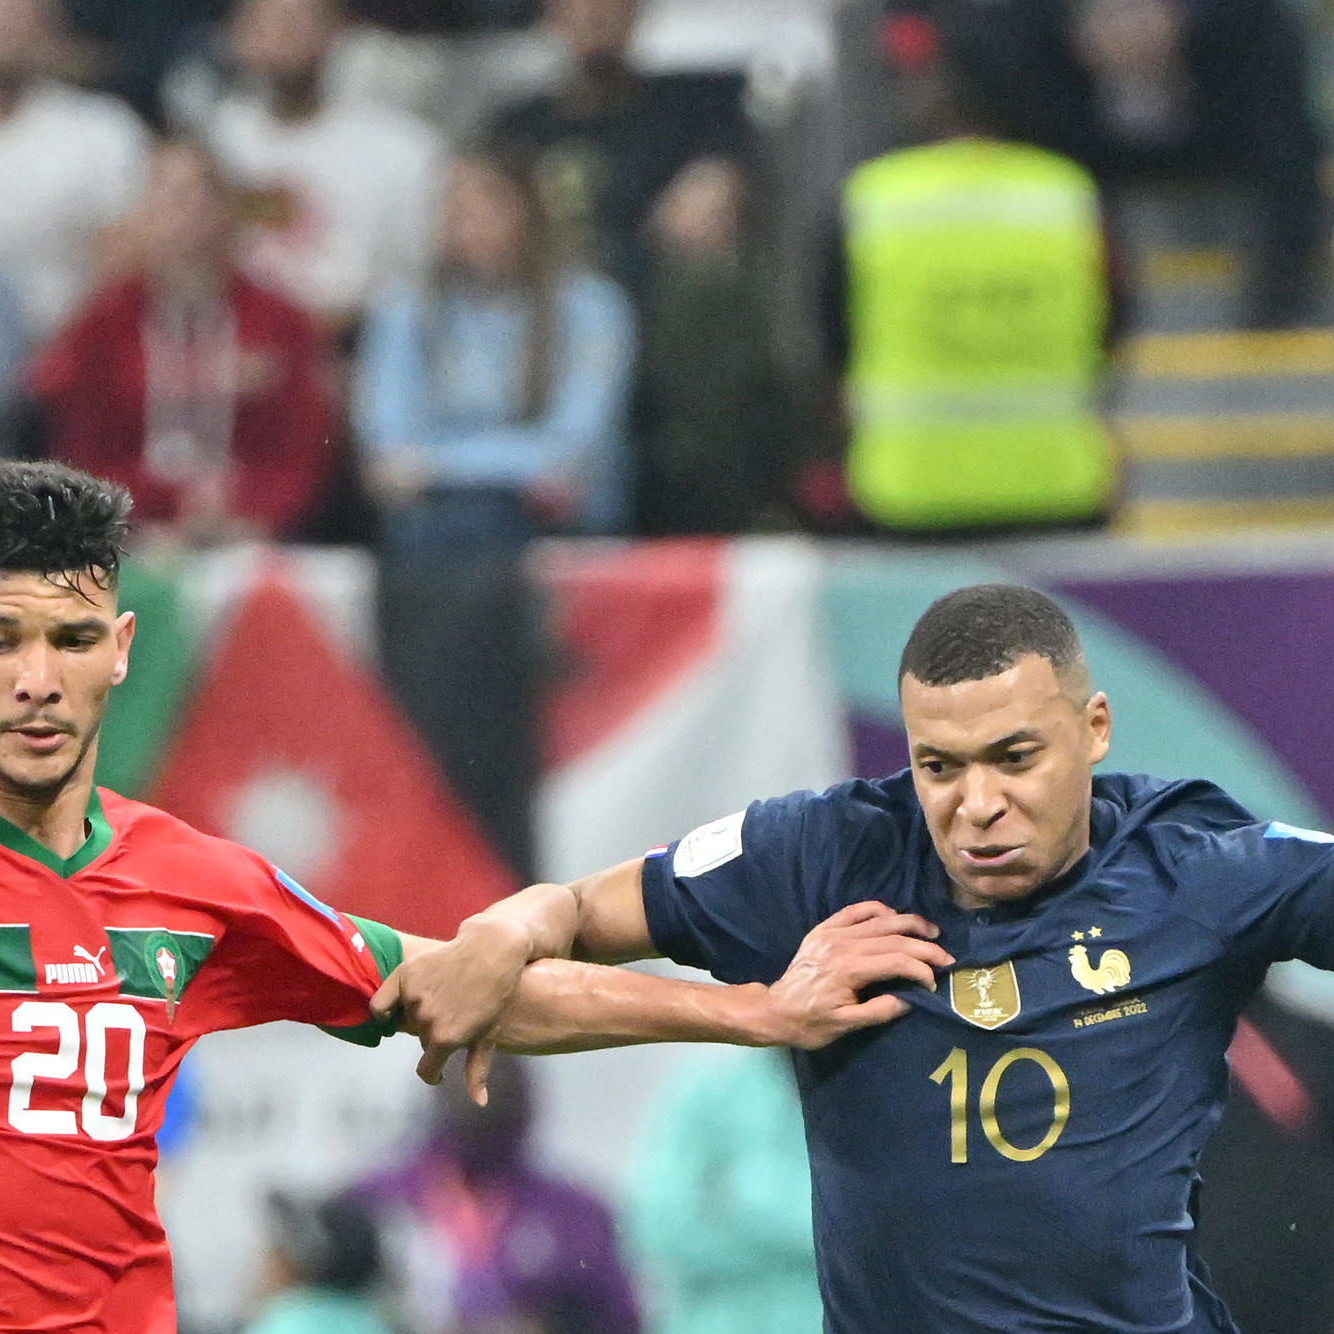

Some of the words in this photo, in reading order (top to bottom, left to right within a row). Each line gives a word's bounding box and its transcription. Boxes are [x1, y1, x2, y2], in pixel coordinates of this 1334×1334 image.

[45, 963, 99, 985] PUMA
[1123, 1002, 1148, 1017] 2022
[8, 1001, 147, 1142] 20
[929, 1046, 1071, 1164] 10
